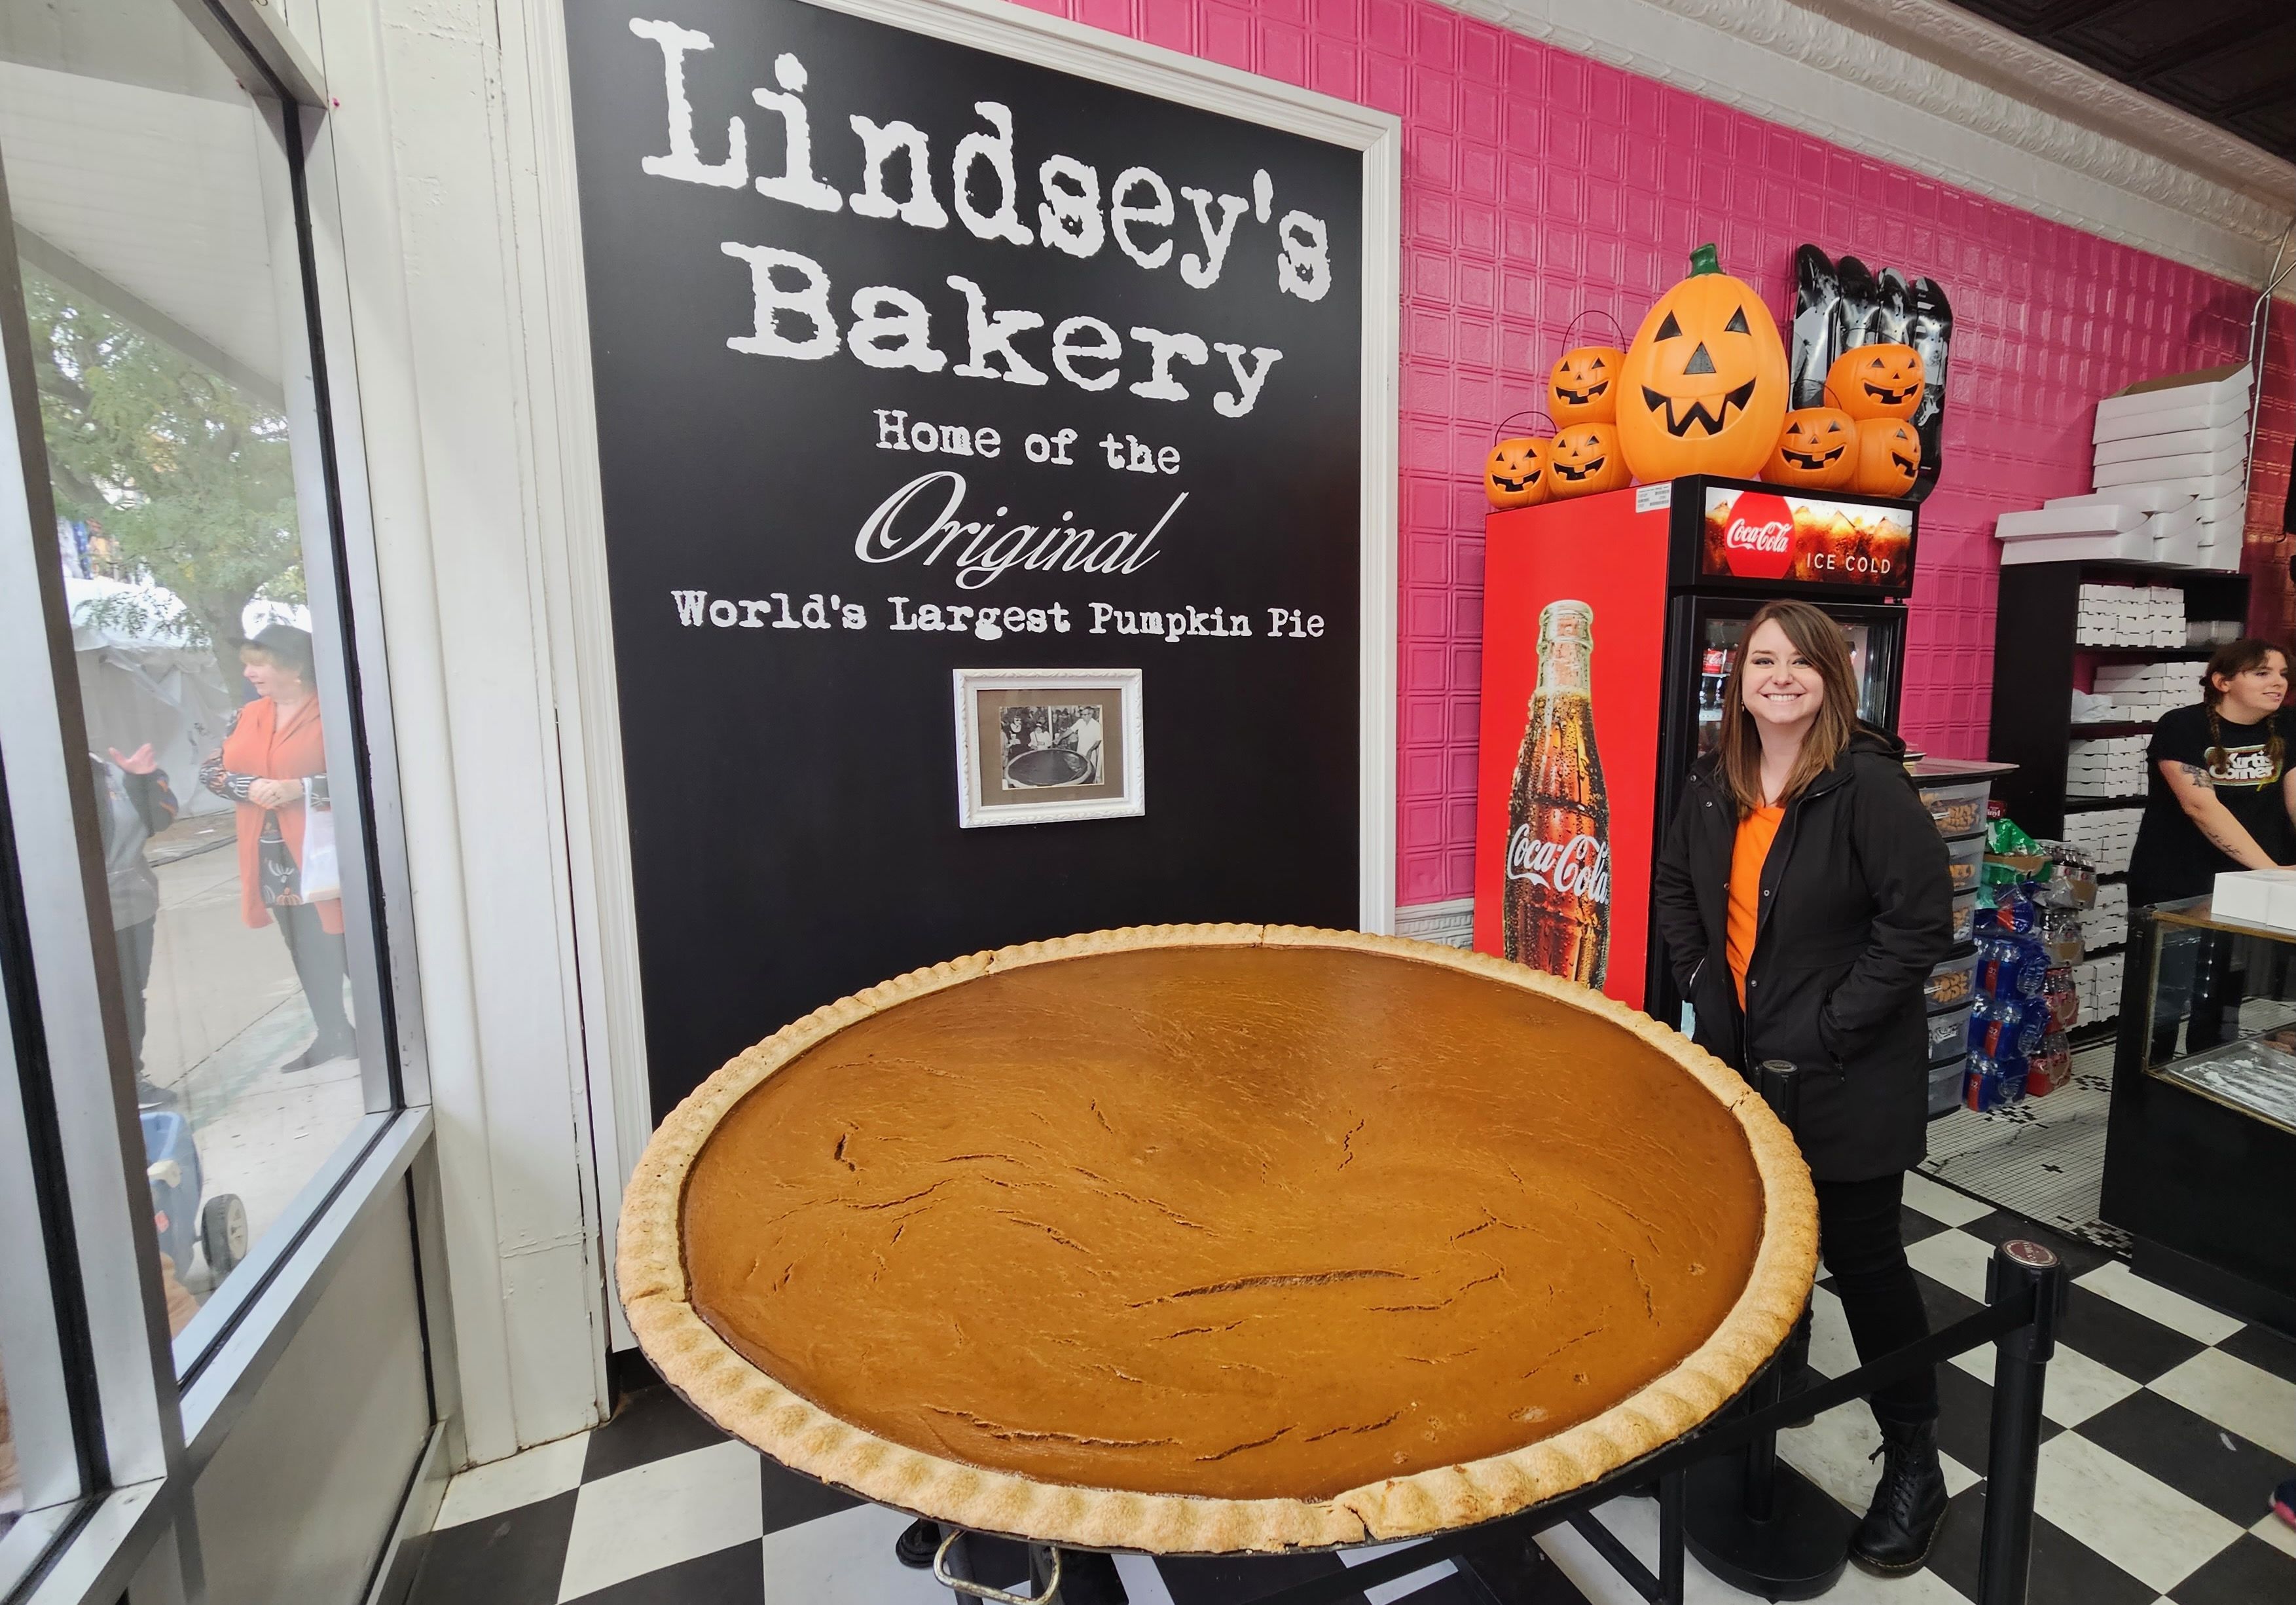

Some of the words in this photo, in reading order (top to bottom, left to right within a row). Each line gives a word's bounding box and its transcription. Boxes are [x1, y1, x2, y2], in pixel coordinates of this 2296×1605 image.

[629, 18, 1332, 303] Lindsey's
[720, 242, 1283, 418] Bakery
[873, 409, 1001, 458] Home
[1025, 428, 1078, 466] of
[1099, 433, 1180, 475] the
[854, 471, 1189, 590] Original
[1727, 518, 1793, 552] Coca-Cola
[1806, 552, 1835, 570] ICE
[1845, 555, 1891, 574] COLD
[670, 590, 867, 630] World's
[887, 596, 1071, 641] Largest
[1089, 602, 1252, 644] Pumpkin
[1267, 608, 1324, 638] Pie
[2210, 765, 2274, 779] Corner
[1507, 823, 1609, 904] Coca-Cola
